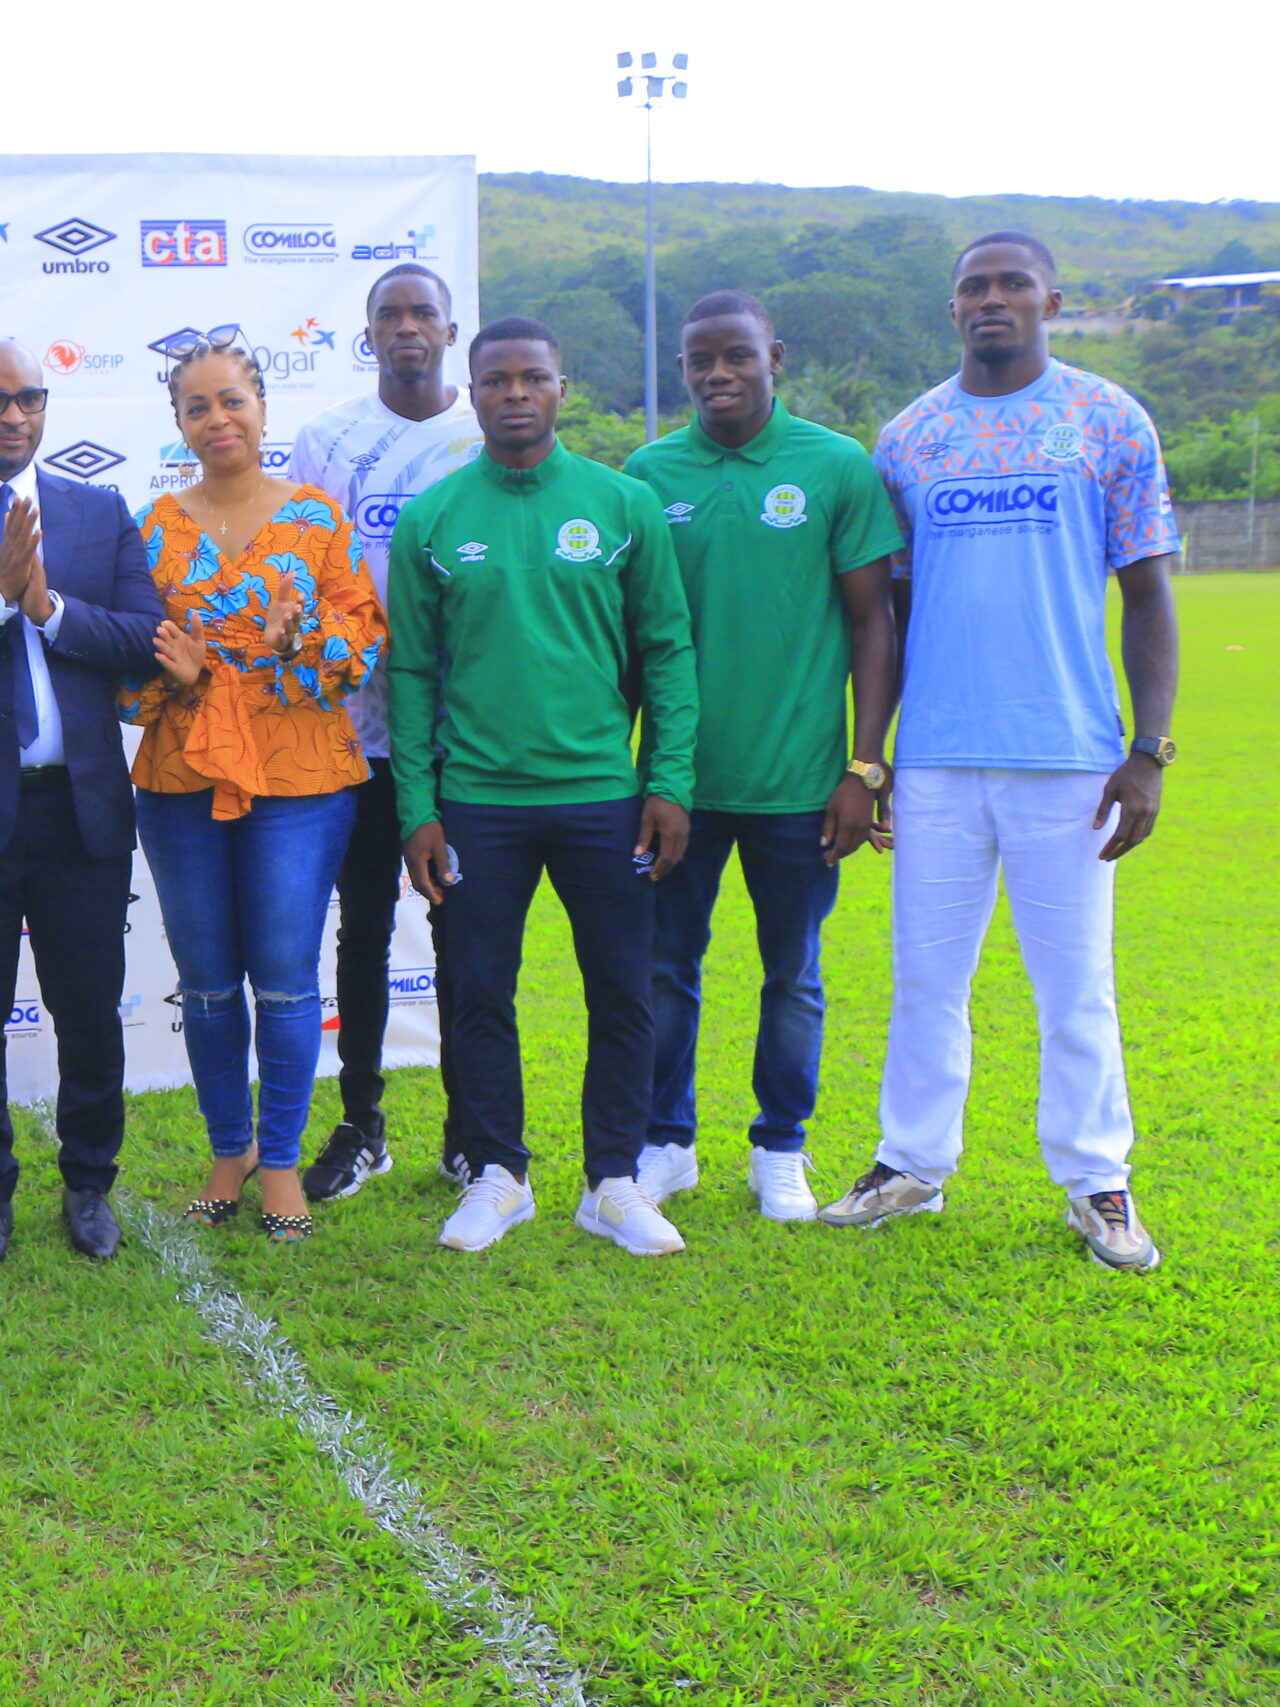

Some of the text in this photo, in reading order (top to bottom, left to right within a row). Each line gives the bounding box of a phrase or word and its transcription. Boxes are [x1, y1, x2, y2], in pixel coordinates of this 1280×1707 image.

[144, 221, 224, 264] cta
[251, 231, 336, 248] COMILOG
[42, 258, 110, 274] umbro
[83, 354, 124, 369] SOFIP
[254, 346, 320, 380] Ogar
[150, 475, 204, 490] APPRO
[935, 483, 1059, 515] COMILOG
[948, 526, 1012, 538] manganese
[461, 554, 485, 562] umbro
[389, 975, 437, 993] MILO
